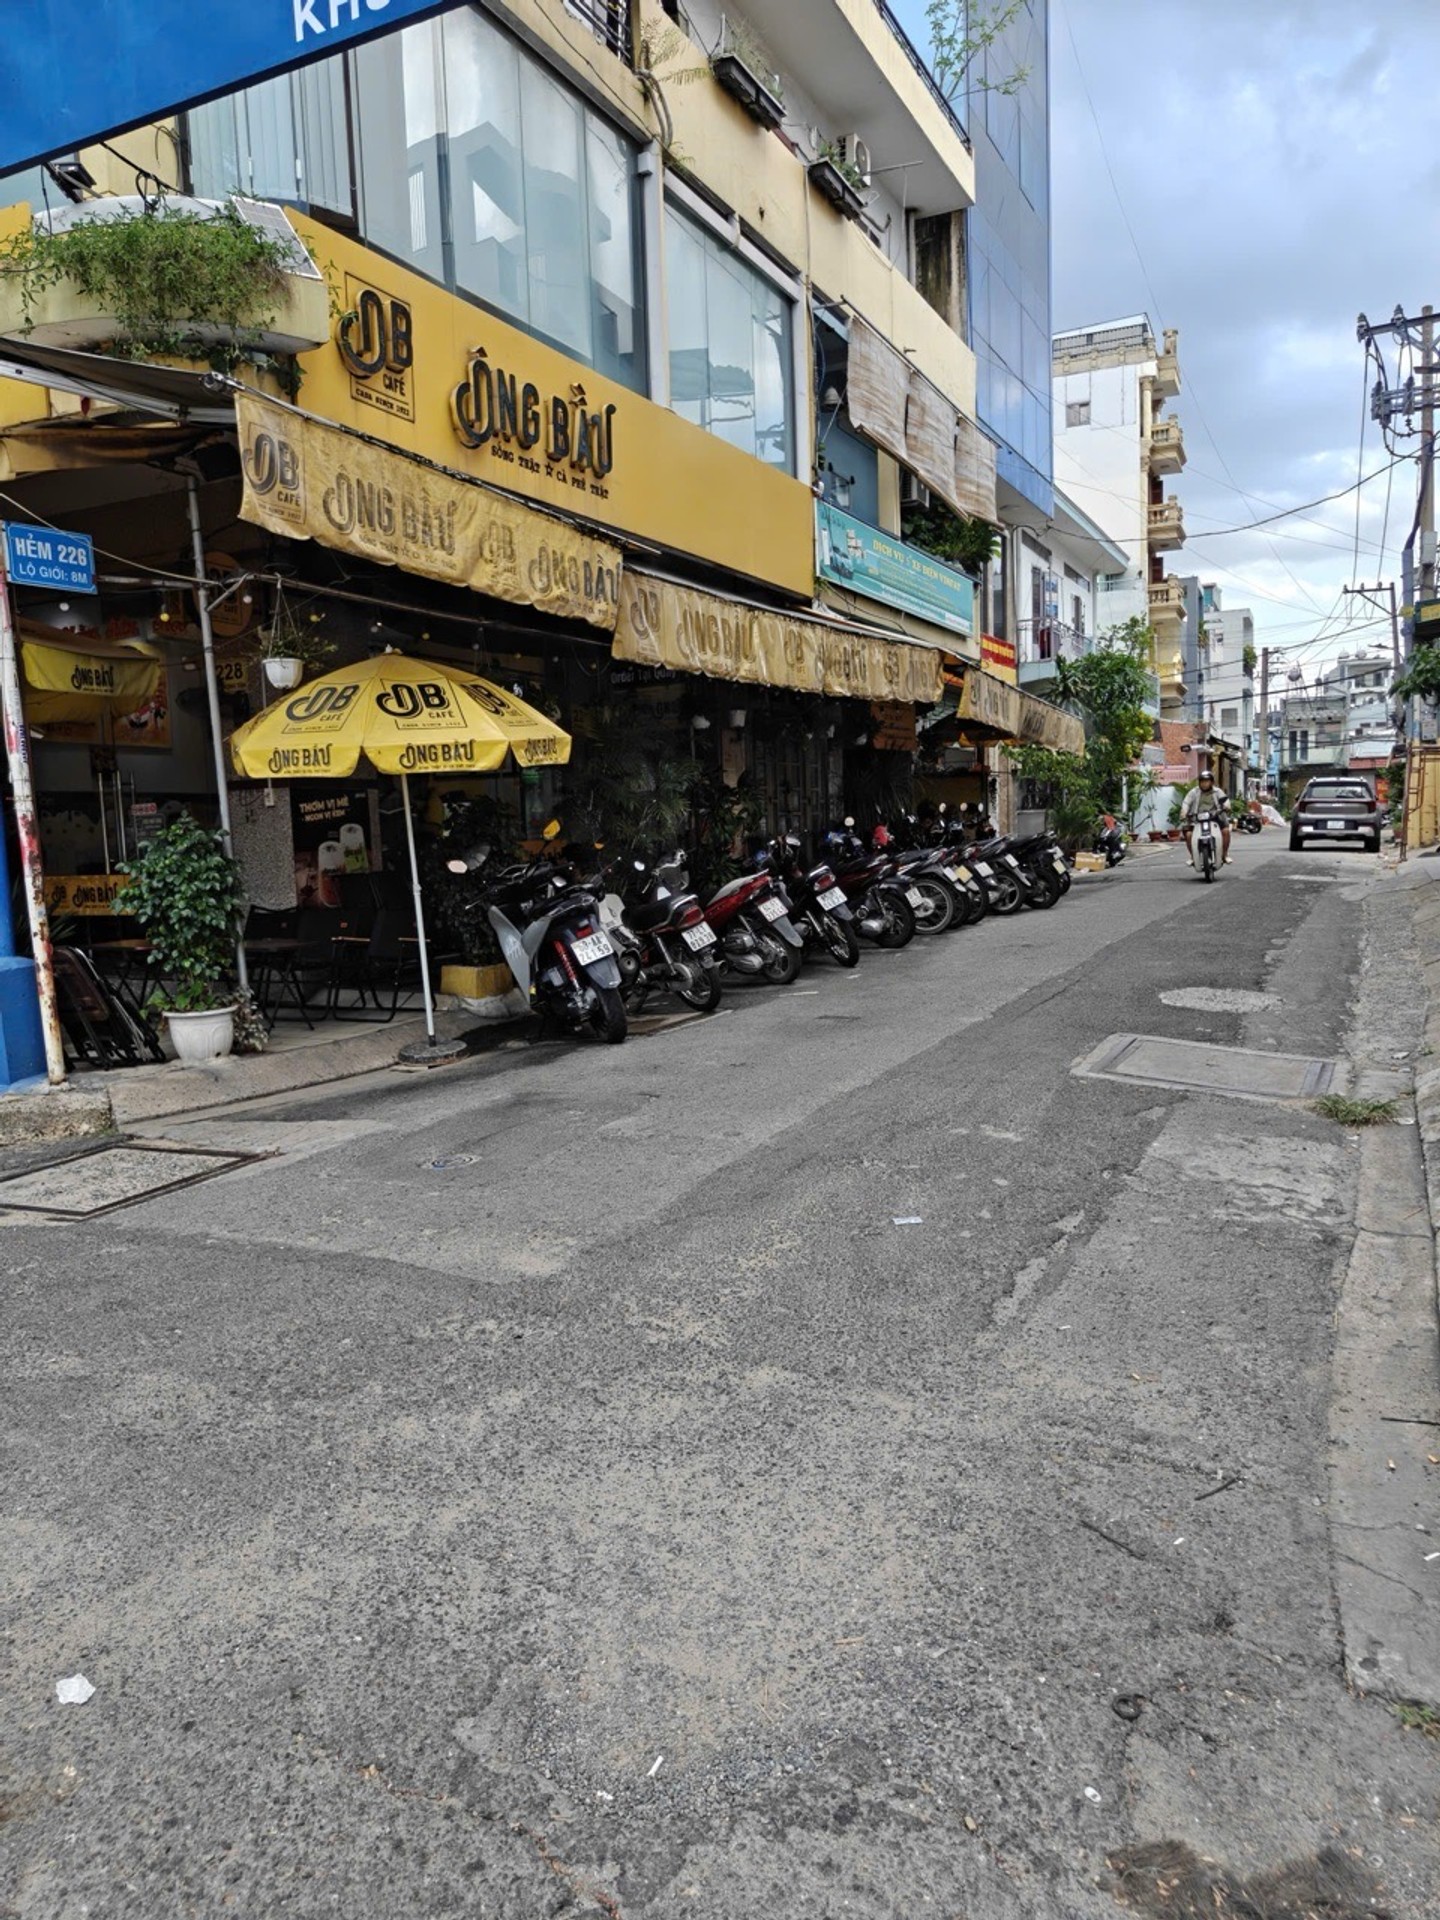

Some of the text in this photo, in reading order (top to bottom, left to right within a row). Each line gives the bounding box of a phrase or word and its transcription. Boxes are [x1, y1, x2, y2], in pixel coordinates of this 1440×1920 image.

[292, 0, 391, 43] KH
[335, 288, 413, 380] OB
[383, 373, 406, 397] CAFÉ
[450, 346, 617, 479] ÔNG BẦU
[242, 433, 300, 495] OB
[322, 464, 395, 536] ÔNG
[401, 487, 459, 556] BẦU
[15, 533, 87, 567] HẺM 226
[528, 540, 580, 594] ÔNG
[19, 562, 88, 584] LỘ GIỚI: 8M
[71, 664, 94, 691] ÔNG
[215, 662, 243, 680] 228
[286, 684, 360, 722] OB
[375, 683, 450, 719] OB
[428, 710, 455, 719] CAFÉ
[268, 747, 300, 774] ÔNG
[399, 739, 477, 769] ÔNG BẦU
[72, 884, 96, 908] ÔNG
